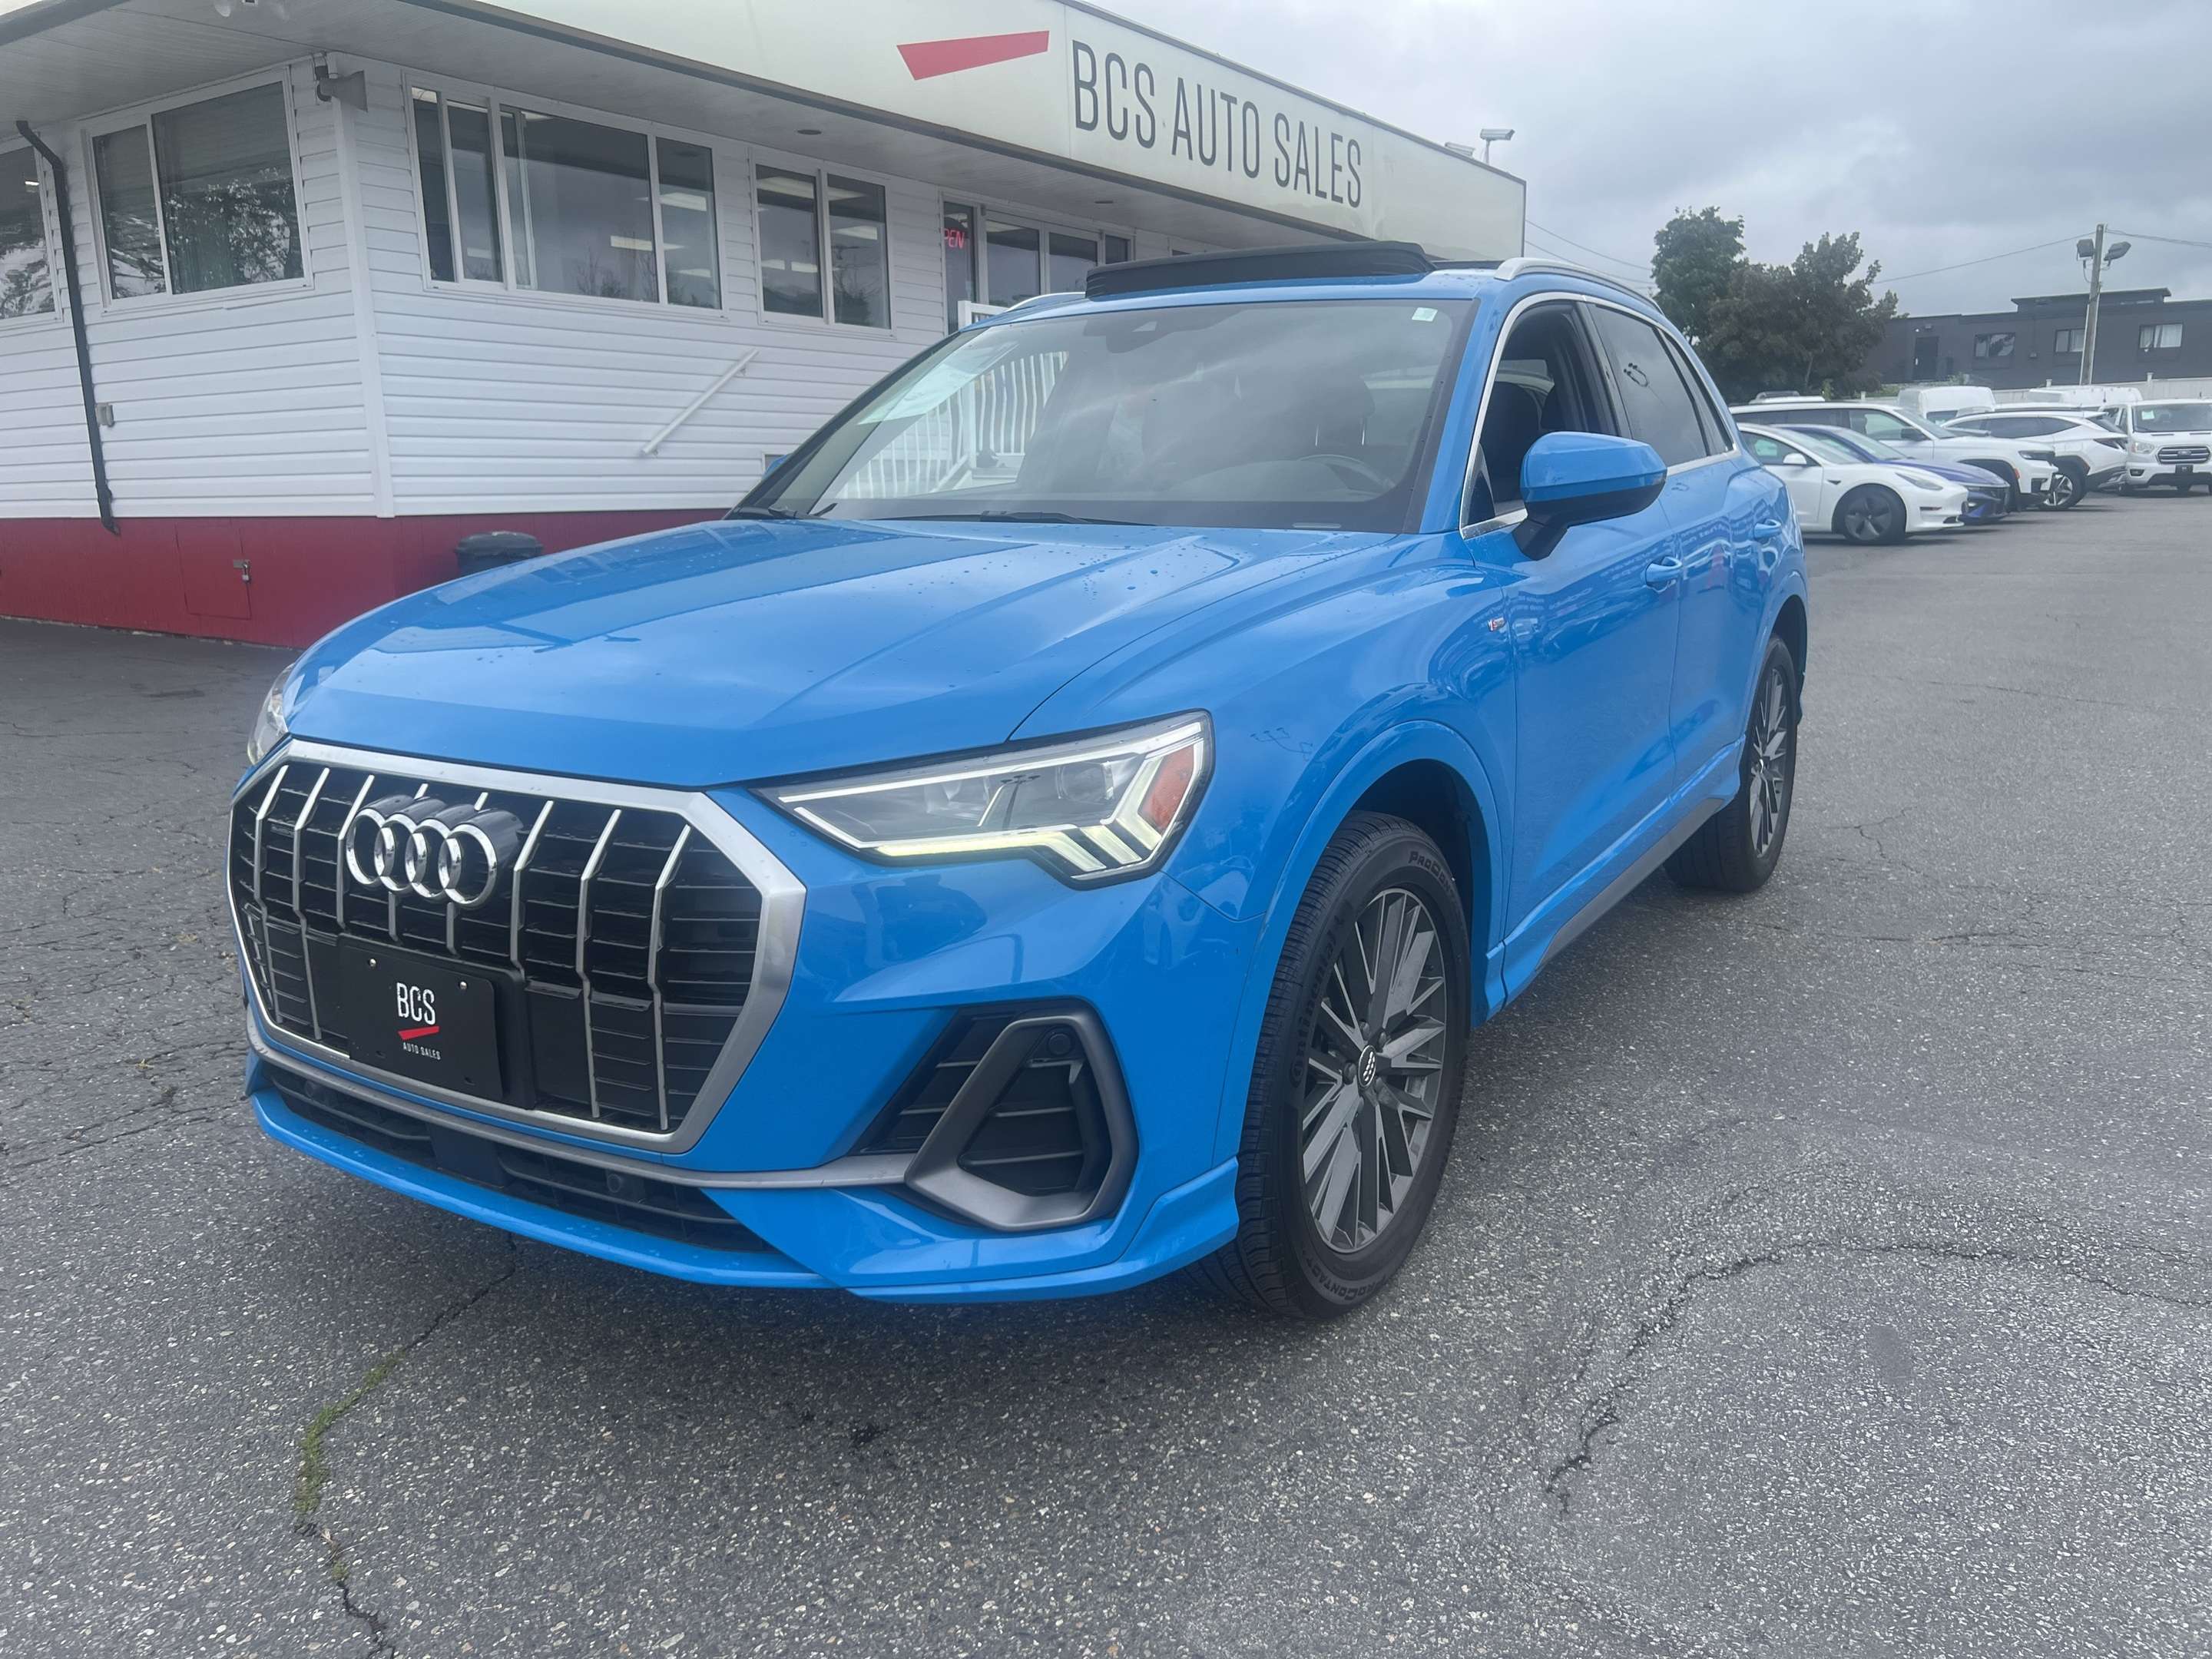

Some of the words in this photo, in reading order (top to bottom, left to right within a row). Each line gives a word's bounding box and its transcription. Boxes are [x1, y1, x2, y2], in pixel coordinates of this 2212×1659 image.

[1072, 39, 1156, 149] BCS
[1171, 76, 1260, 179] AUTO
[1273, 111, 1362, 208] SALES
[944, 228, 965, 250] PEN
[396, 982, 435, 1025] BCS
[403, 1041, 419, 1055] AUTO
[420, 1046, 441, 1061] SALES
